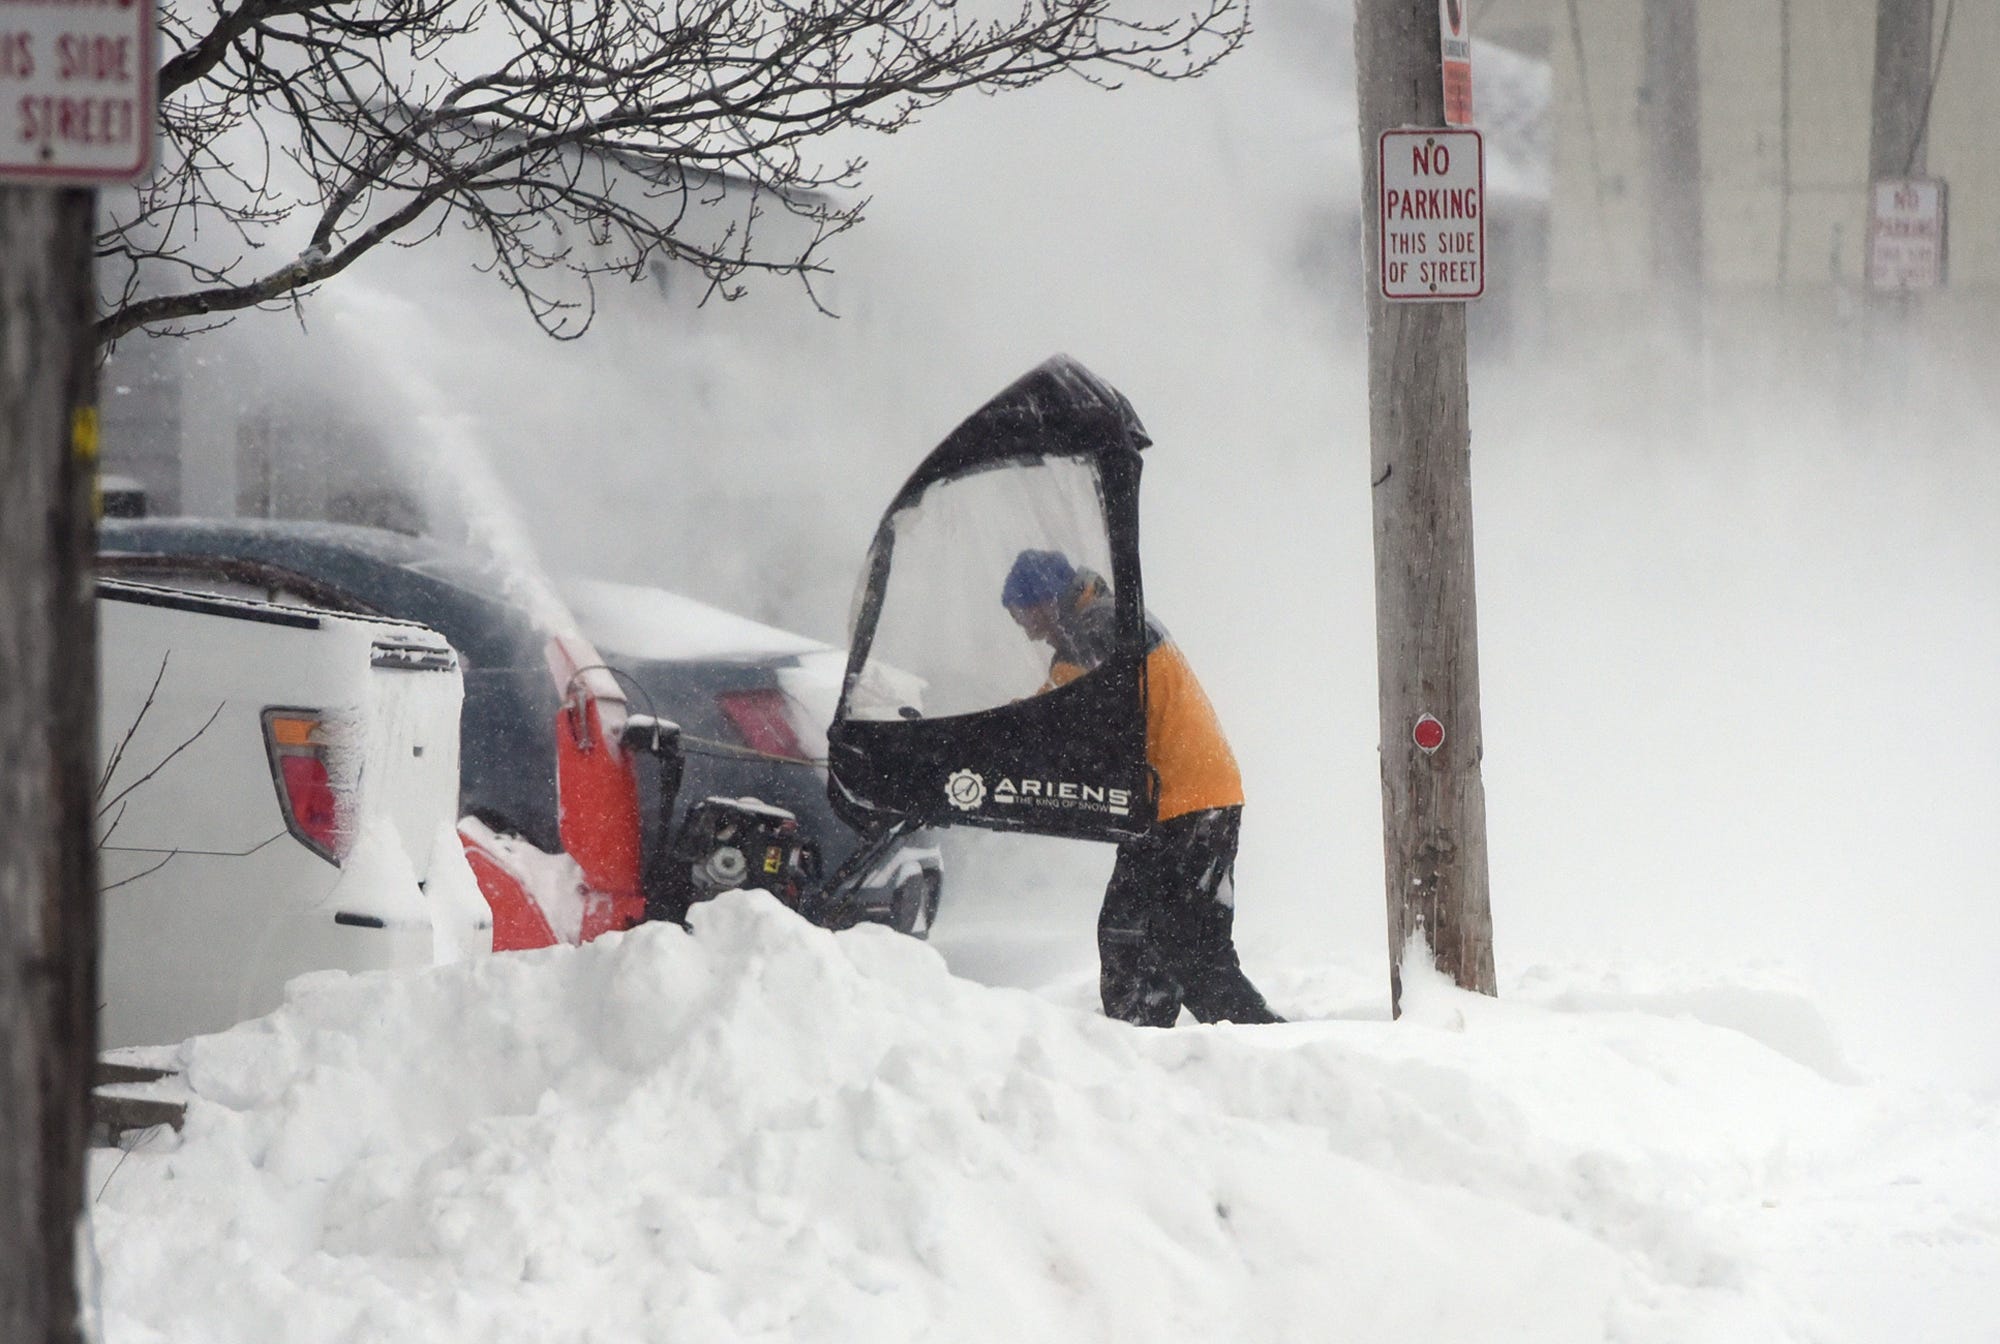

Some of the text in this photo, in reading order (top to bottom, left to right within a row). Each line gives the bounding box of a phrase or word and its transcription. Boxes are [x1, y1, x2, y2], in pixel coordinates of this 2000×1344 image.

[56, 32, 131, 82] SIDE
[19, 94, 133, 143] STREET
[1412, 145, 1450, 176] NO
[1387, 187, 1477, 220] PARKING
[1390, 231, 1475, 254] THIS SIDE
[1389, 261, 1477, 283] OF STREET
[994, 777, 1129, 806] ARIENS
[1014, 796, 1109, 812] THE KING OF SNOW
